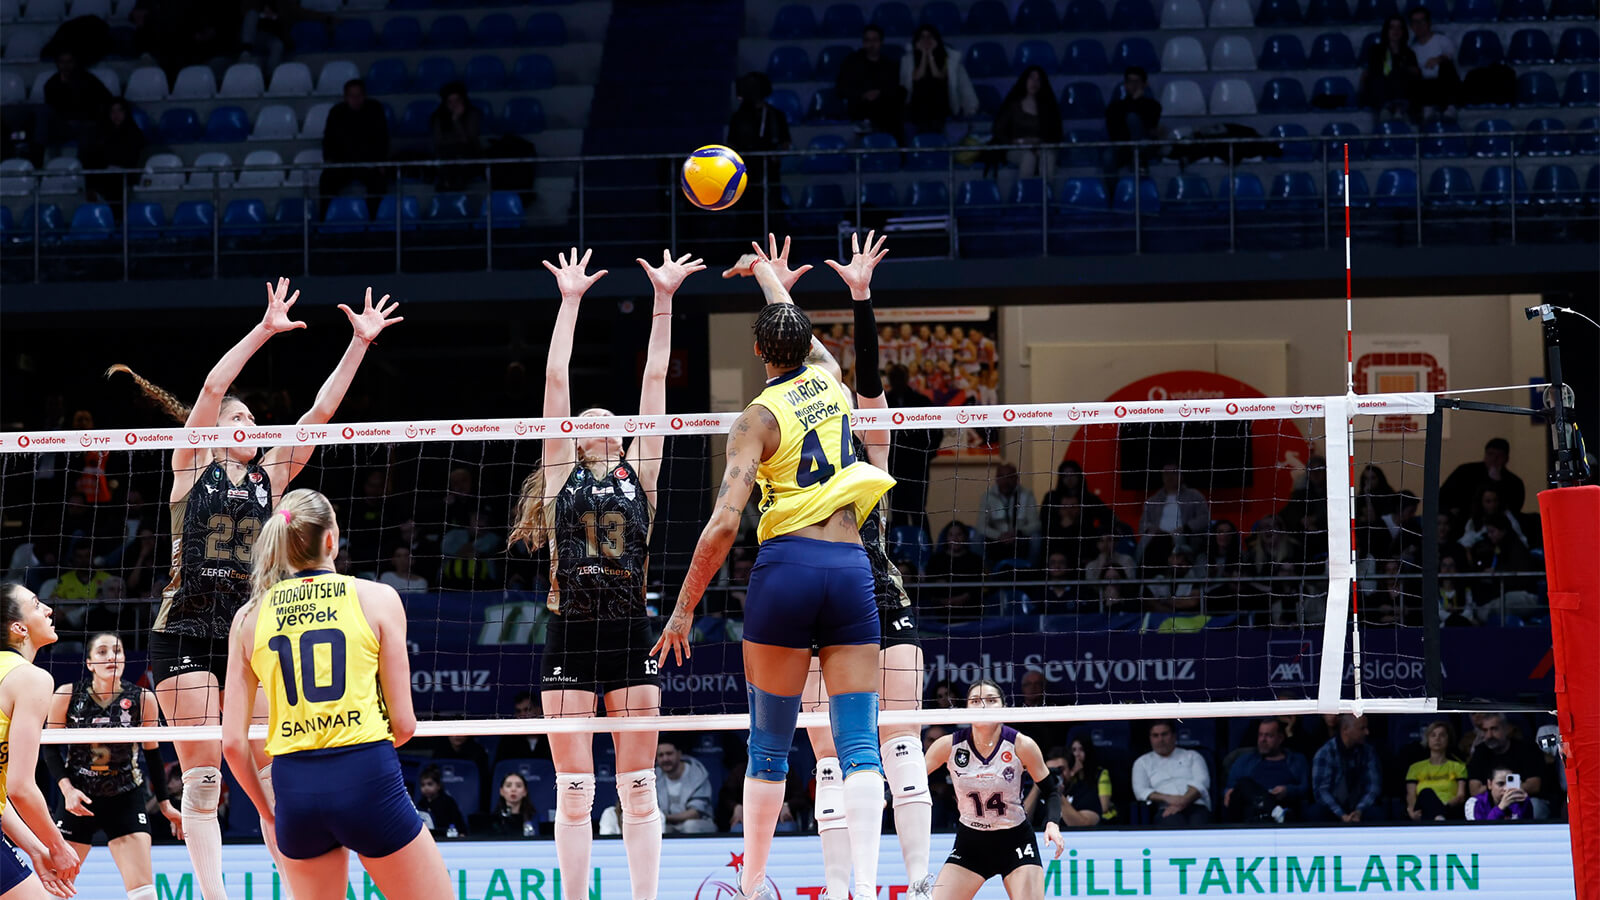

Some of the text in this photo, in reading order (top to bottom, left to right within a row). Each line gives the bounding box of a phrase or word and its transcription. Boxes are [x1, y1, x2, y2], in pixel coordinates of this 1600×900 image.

[784, 376, 829, 407] VARGAS
[31, 436, 66, 445] vodafone
[93, 436, 111, 444] TVF
[139, 433, 174, 443] vodafone
[201, 433, 219, 442] TVF
[247, 430, 282, 440] vodafone
[310, 431, 328, 439] TVF
[355, 427, 391, 437] vodafone
[419, 427, 437, 436] TVF
[464, 424, 501, 434] vodafone
[528, 424, 546, 433] TVF
[574, 421, 610, 431] vodafone
[638, 421, 656, 430] TVF
[684, 418, 721, 428] vodafone
[859, 415, 877, 424] TVF
[905, 413, 942, 422] vodafone
[970, 413, 989, 421] TVF
[1016, 409, 1053, 419] vodafone
[1081, 409, 1100, 418] TVF
[1128, 406, 1165, 415] vodafone
[1192, 406, 1211, 415] TVF
[1239, 403, 1276, 413] vodafone
[1304, 403, 1323, 412] TVF
[204, 513, 262, 563] 23
[580, 511, 626, 558] 13
[276, 606, 338, 632] yemek
[892, 615, 914, 631] 15
[268, 628, 346, 707] 10
[644, 660, 658, 674] 13
[923, 652, 1196, 690] ybolu Seviyoruz
[1270, 664, 1302, 680] AXA
[281, 711, 362, 738] SANMAR
[968, 792, 1008, 818] 14
[1015, 843, 1035, 859] 14
[1044, 848, 1479, 896] MİLLİ TAKIMLARIN
